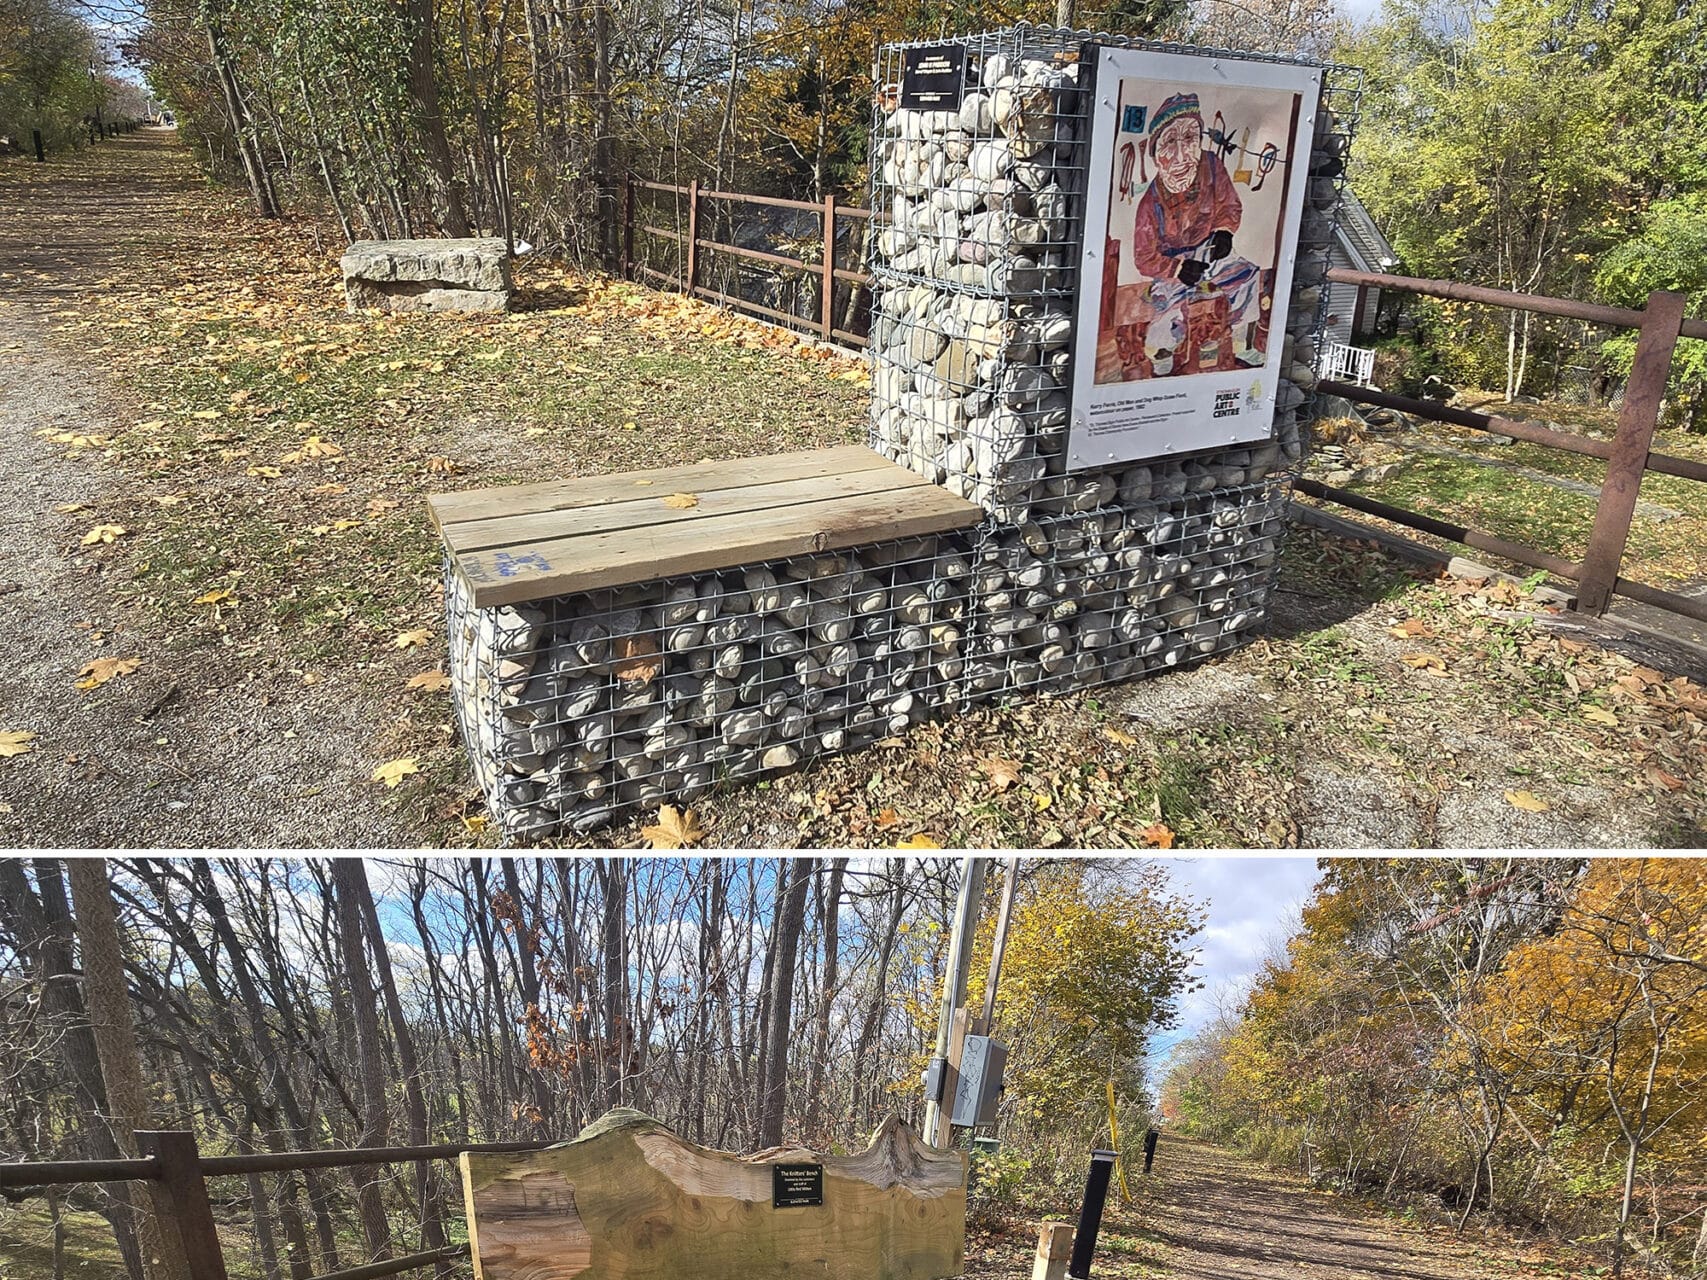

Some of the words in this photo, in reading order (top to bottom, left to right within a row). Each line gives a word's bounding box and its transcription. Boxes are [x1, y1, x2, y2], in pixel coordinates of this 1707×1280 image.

[1215, 392, 1241, 402] PUBLIC
[1214, 401, 1228, 410] ART
[1213, 408, 1241, 418] CENTRE
